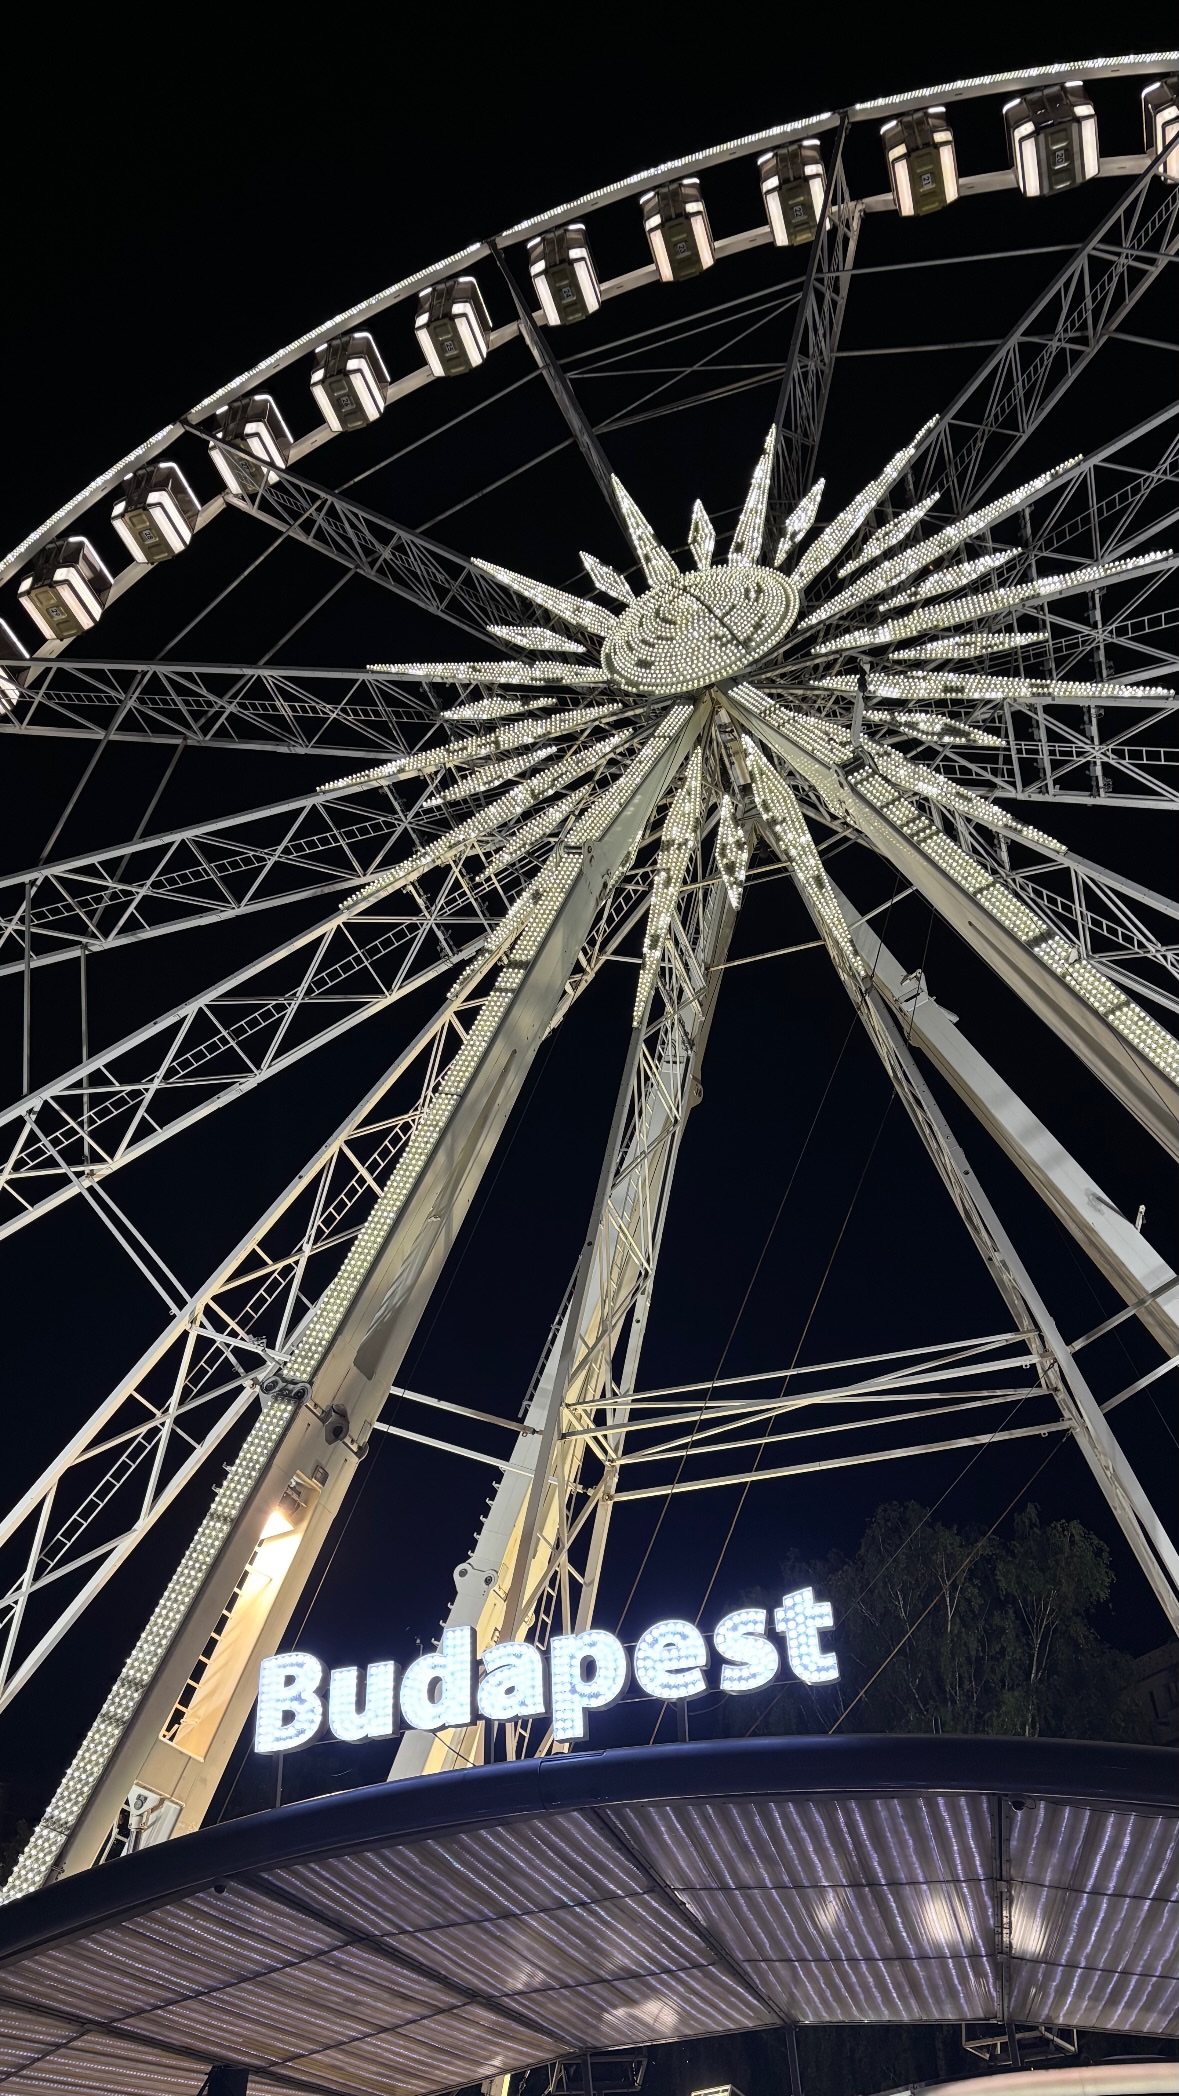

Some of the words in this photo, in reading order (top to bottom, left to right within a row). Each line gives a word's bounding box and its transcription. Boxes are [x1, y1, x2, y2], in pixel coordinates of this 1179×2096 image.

[1056, 152, 1064, 164] 20
[923, 176, 931, 186] 21
[794, 206, 802, 217] 22
[445, 342, 454, 352] 25
[254, 1586, 839, 1755] Budapest
